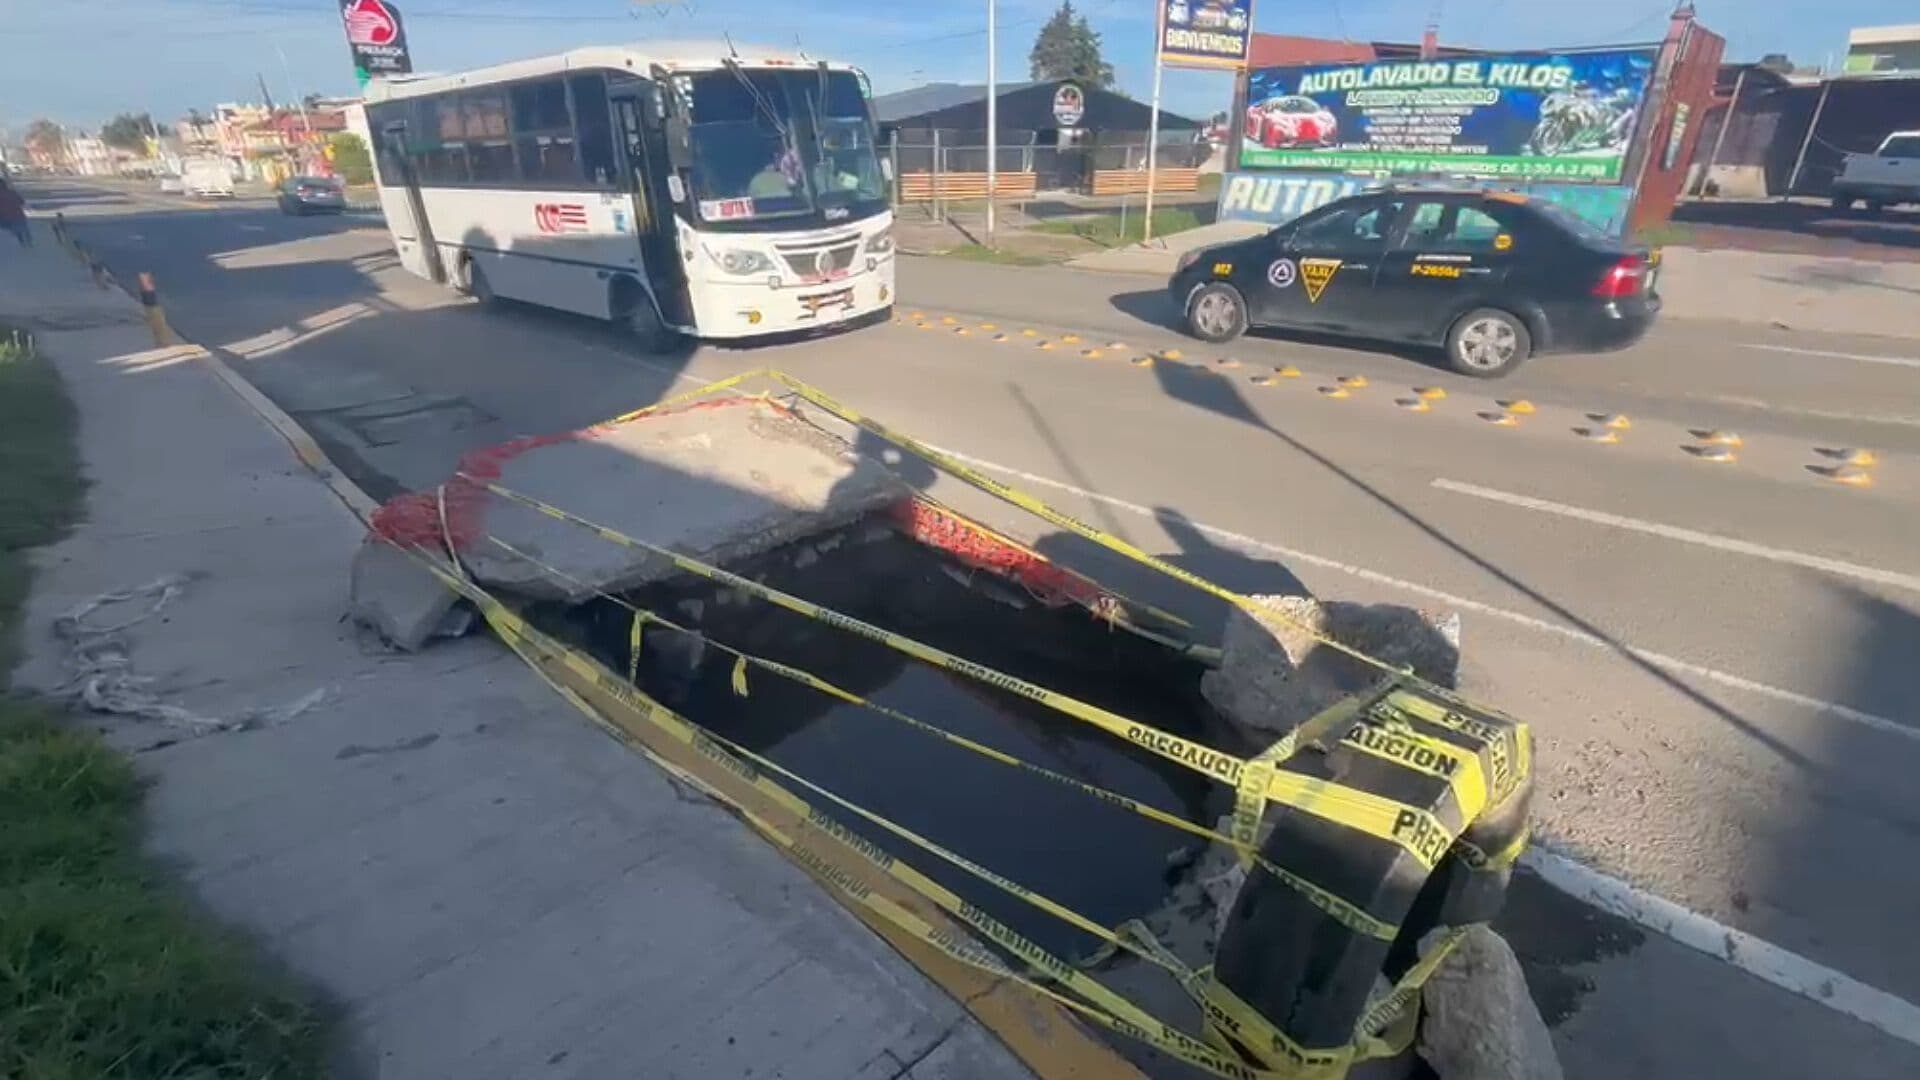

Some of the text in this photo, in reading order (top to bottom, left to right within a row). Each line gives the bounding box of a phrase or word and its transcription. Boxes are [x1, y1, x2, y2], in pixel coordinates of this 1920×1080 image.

[1299, 63, 1574, 94] AUTOLAVADO EL KILOS
